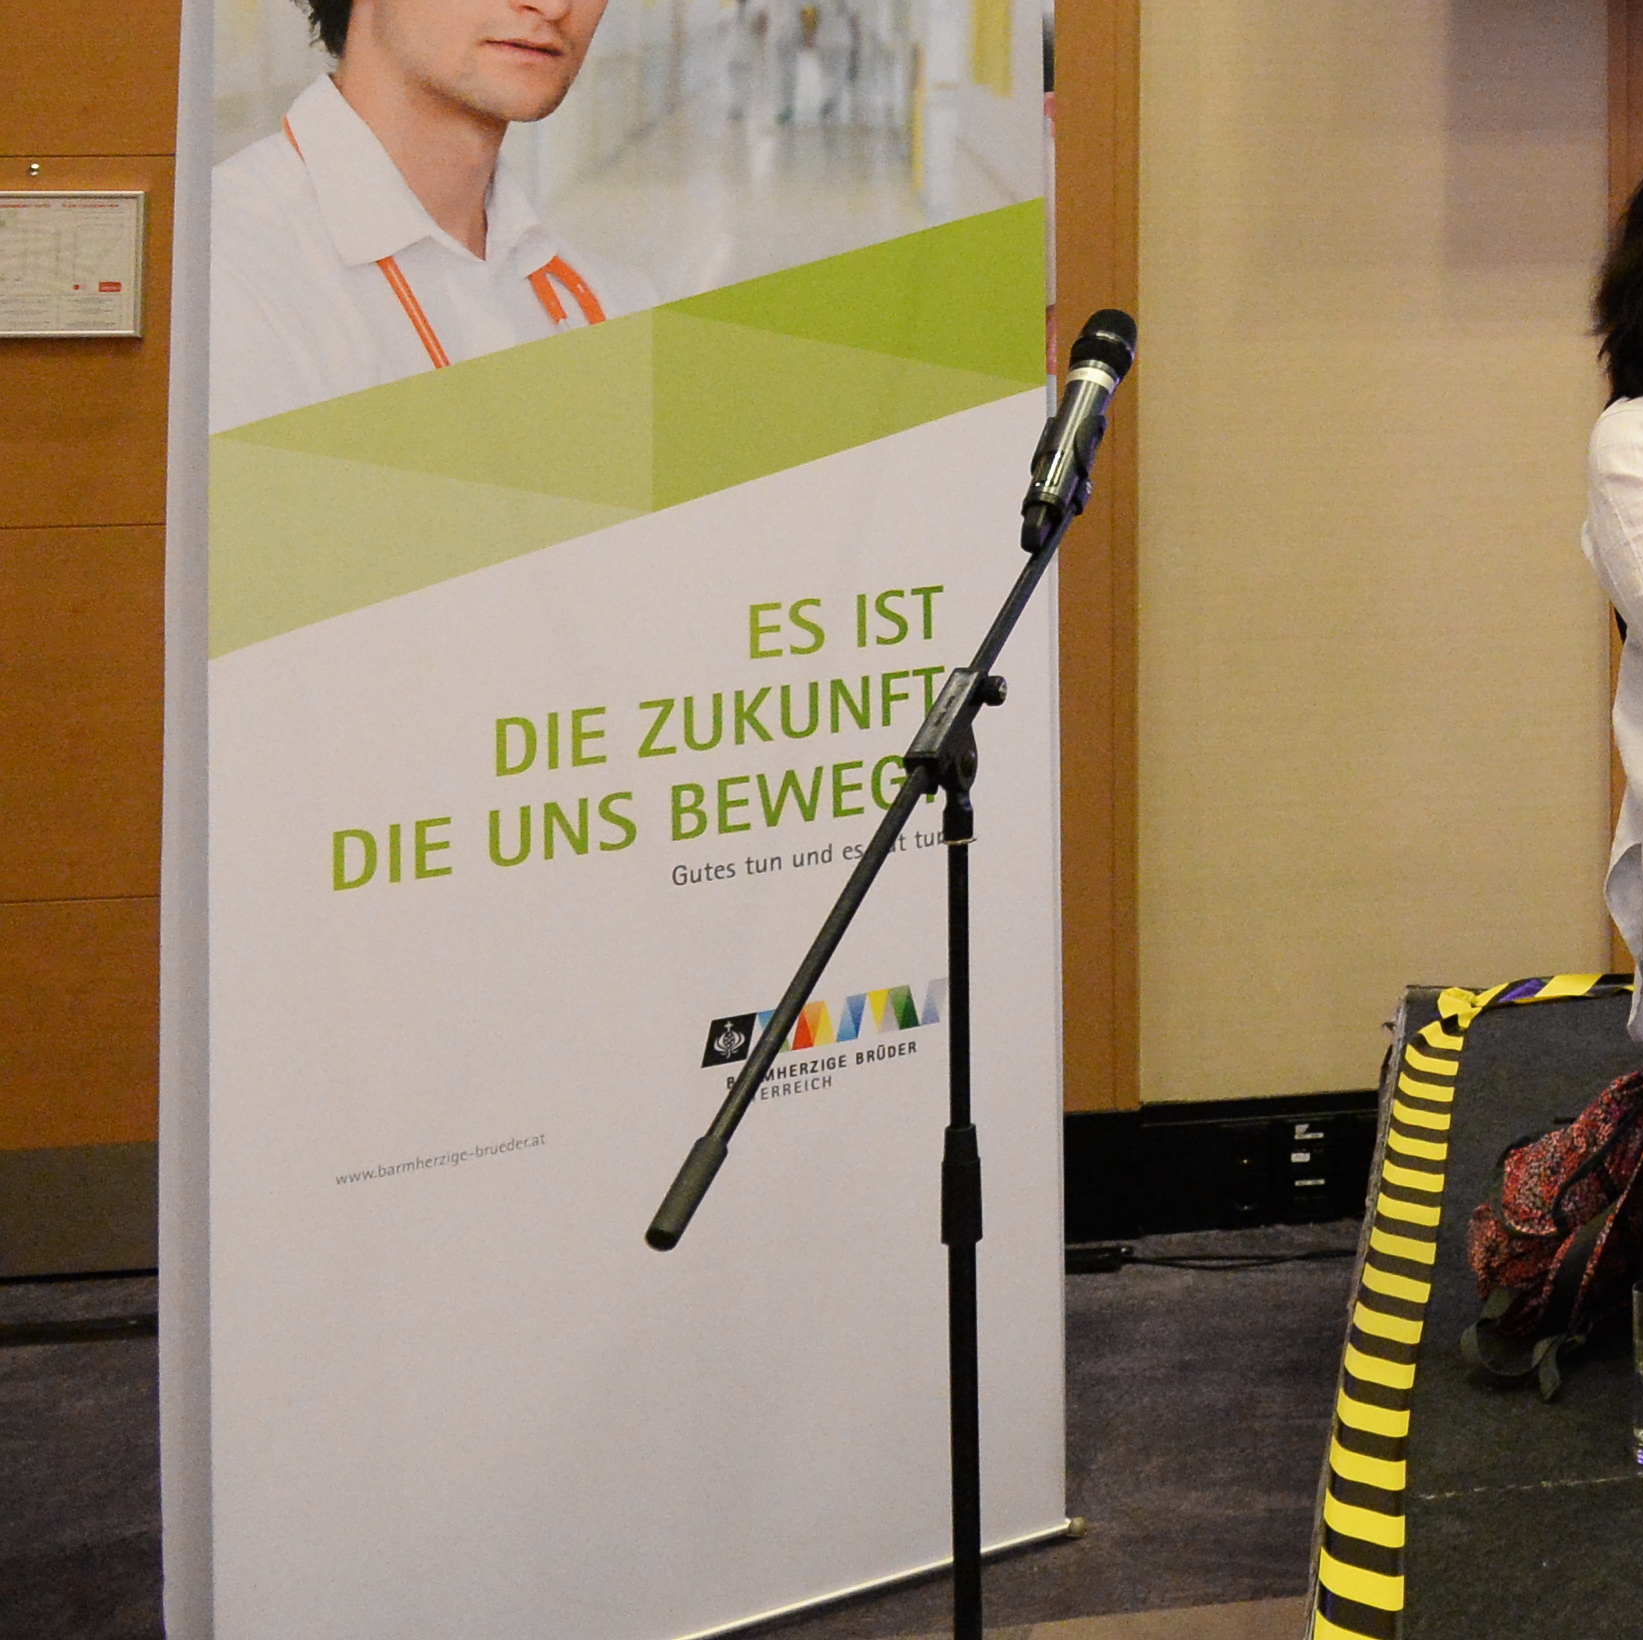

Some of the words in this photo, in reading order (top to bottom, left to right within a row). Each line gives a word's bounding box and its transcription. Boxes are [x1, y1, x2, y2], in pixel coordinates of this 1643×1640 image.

[748, 597, 826, 660] ES
[856, 584, 945, 648] IST
[494, 705, 608, 778] DIE
[637, 665, 946, 759] ZUKUNFT
[332, 816, 453, 892] DIE
[487, 790, 638, 868] UNS
[670, 754, 938, 843] BEWEG
[672, 862, 737, 887] Gutes
[746, 855, 783, 877] tun
[792, 843, 833, 868] und
[842, 842, 864, 861] es
[726, 1054, 848, 1091] BMHERZIGE
[854, 1040, 918, 1066] BRÜDER
[334, 1133, 546, 1186] www.barmherzige-brueder.at
